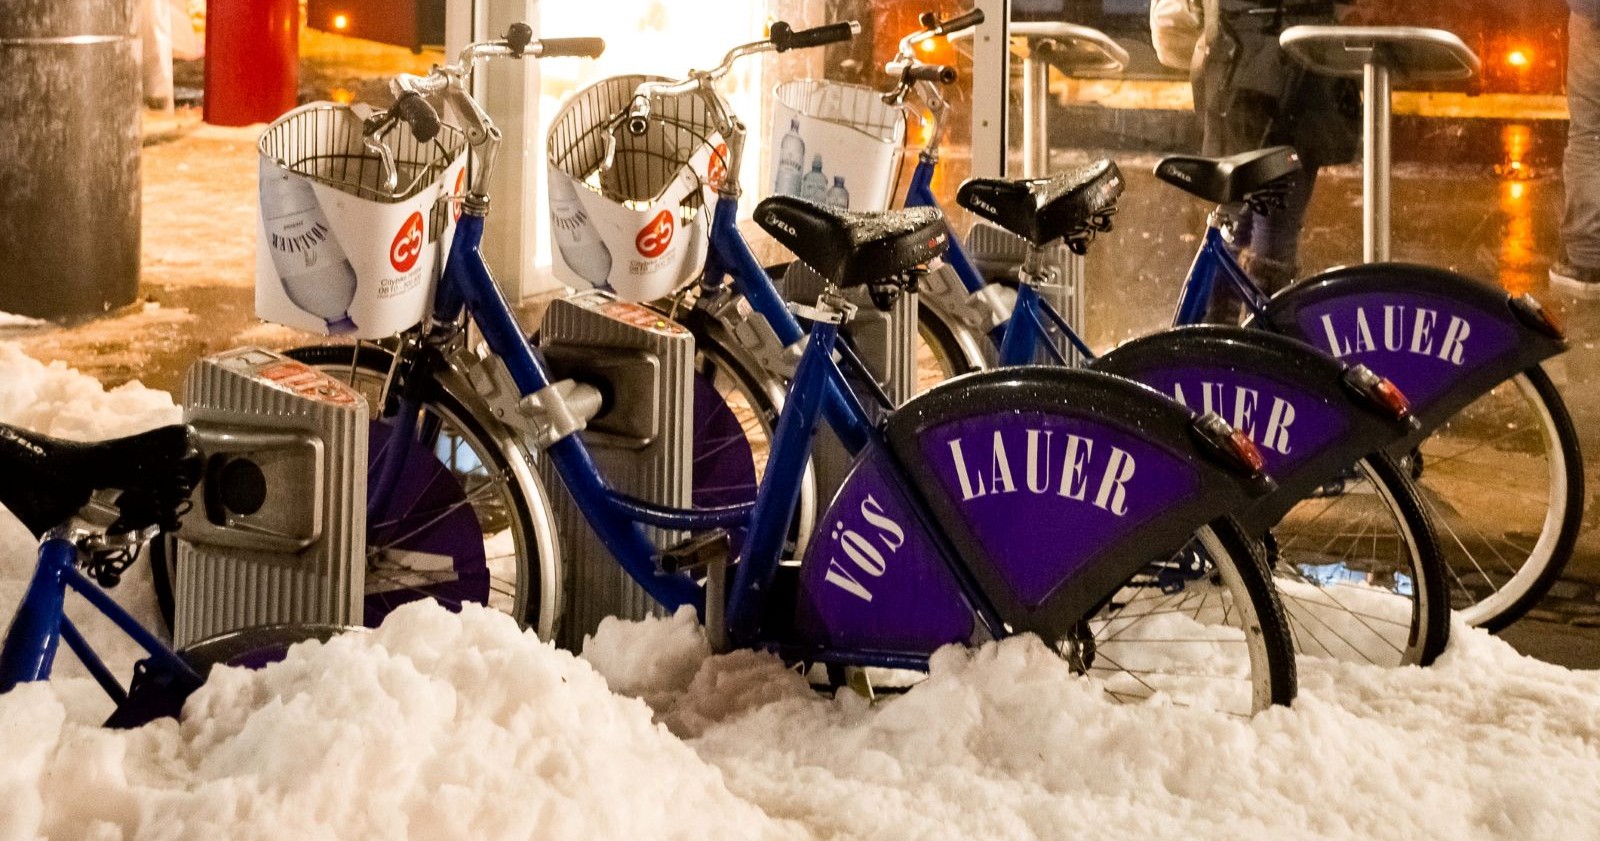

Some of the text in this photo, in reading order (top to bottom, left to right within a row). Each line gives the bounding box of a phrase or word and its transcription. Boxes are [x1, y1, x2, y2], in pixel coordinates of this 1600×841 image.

[772, 216, 797, 237] VELO
[974, 197, 999, 215] VELO
[1320, 305, 1471, 366] LAUER
[947, 429, 1136, 517] LAUER
[824, 493, 905, 603] VÖS
